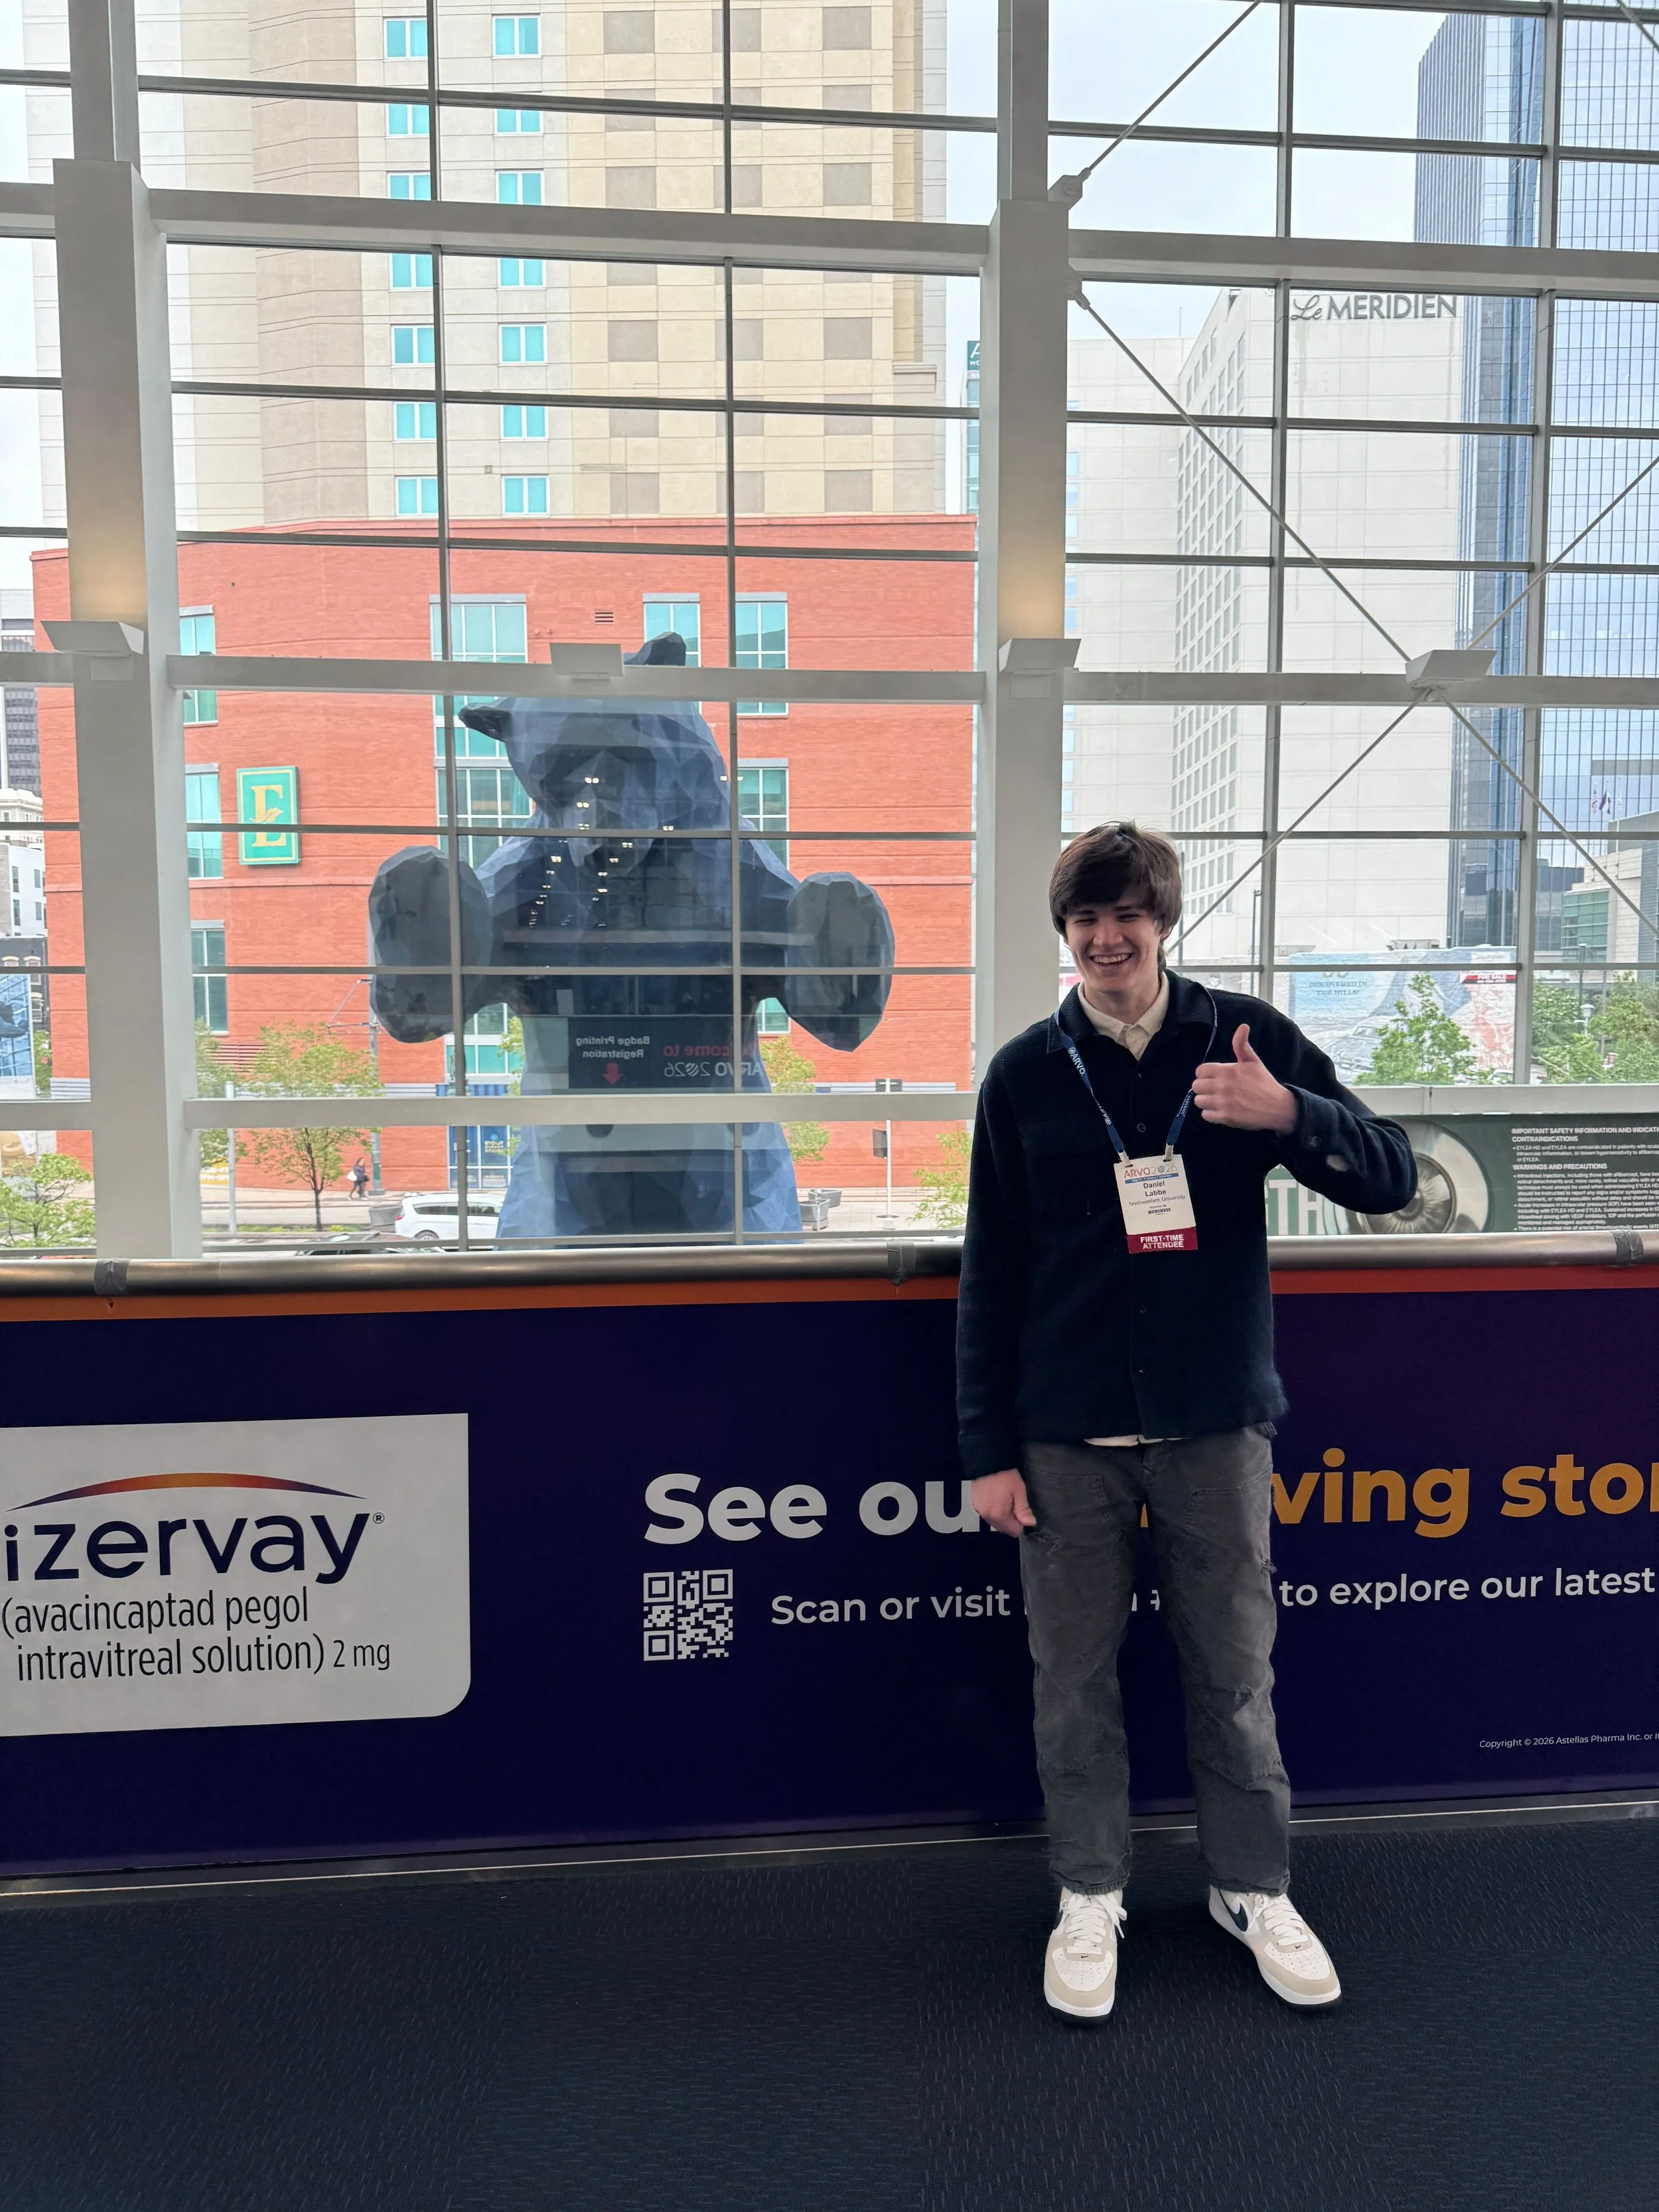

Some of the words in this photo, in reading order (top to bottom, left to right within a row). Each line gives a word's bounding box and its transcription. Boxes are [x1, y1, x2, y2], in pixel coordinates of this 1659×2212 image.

[1291, 295, 1323, 321] Le
[1327, 294, 1457, 320] MERIDIEN
[250, 784, 287, 847] E
[1140, 1234, 1185, 1243] FIRST-TIME
[1143, 1241, 1185, 1250] ATTENDEE
[644, 1473, 828, 1545] See
[859, 1480, 999, 1536] ou
[1500, 1453, 1659, 1518] sto
[2, 1590, 215, 1639] (avacincaptad
[226, 1586, 309, 1631] pegol
[770, 1595, 867, 1625] Scan
[880, 1596, 920, 1621] or
[930, 1585, 1011, 1619] visit
[1279, 1580, 1319, 1607] to
[1329, 1573, 1470, 1611] explore
[1480, 1574, 1544, 1599] our
[1555, 1567, 1656, 1597] latest
[17, 1638, 182, 1682] intravitreal
[192, 1633, 325, 1675] solution)
[333, 1640, 345, 1668] 2
[353, 1641, 391, 1671] mg
[1479, 1738, 1522, 1749] Copyright
[1533, 1737, 1554, 1745] 2026
[1555, 1735, 1589, 1745] Astellas
[1591, 1734, 1624, 1743] Pharma
